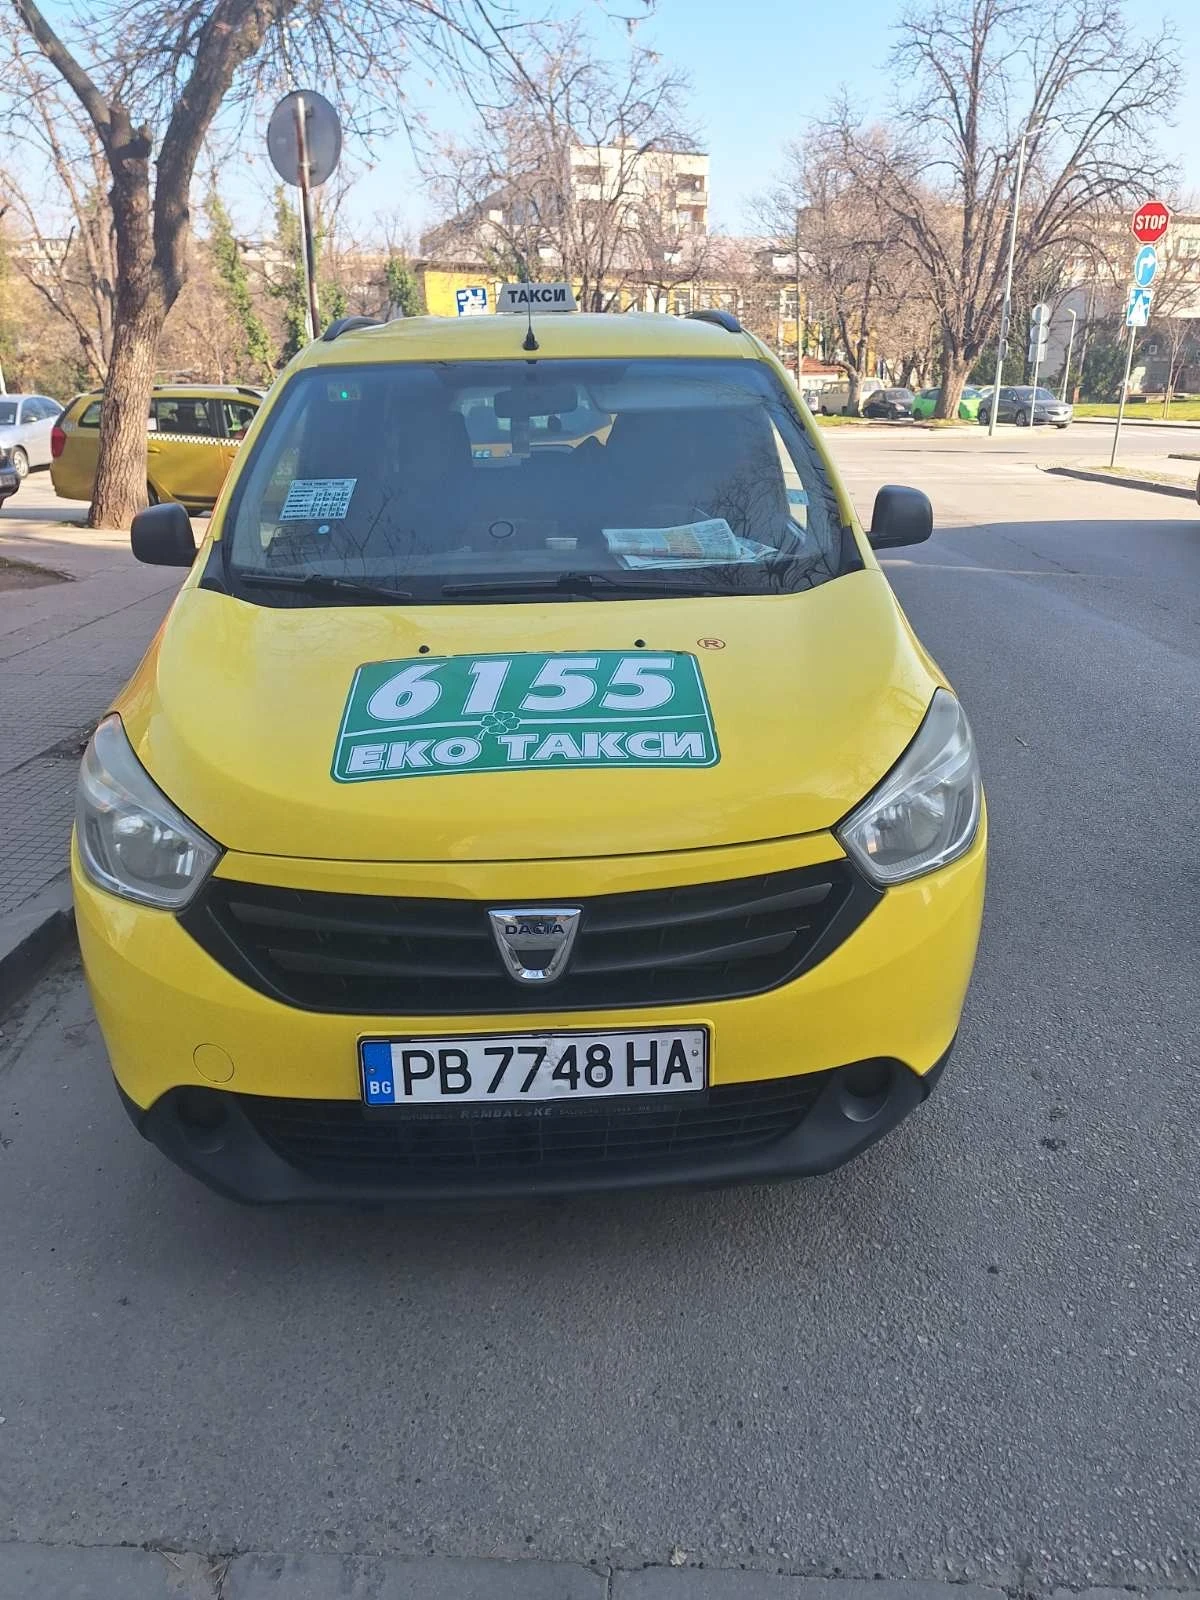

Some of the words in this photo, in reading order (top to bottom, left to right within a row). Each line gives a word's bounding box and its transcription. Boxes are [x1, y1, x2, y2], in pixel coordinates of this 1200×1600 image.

[1135, 214, 1167, 231] STOP
[507, 288, 566, 304] ТАКСИ
[366, 657, 676, 722] 6155
[345, 737, 483, 773] ЕКО
[498, 731, 706, 763] ТАКСИ
[504, 922, 565, 935] DACIA
[369, 1080, 392, 1095] BG
